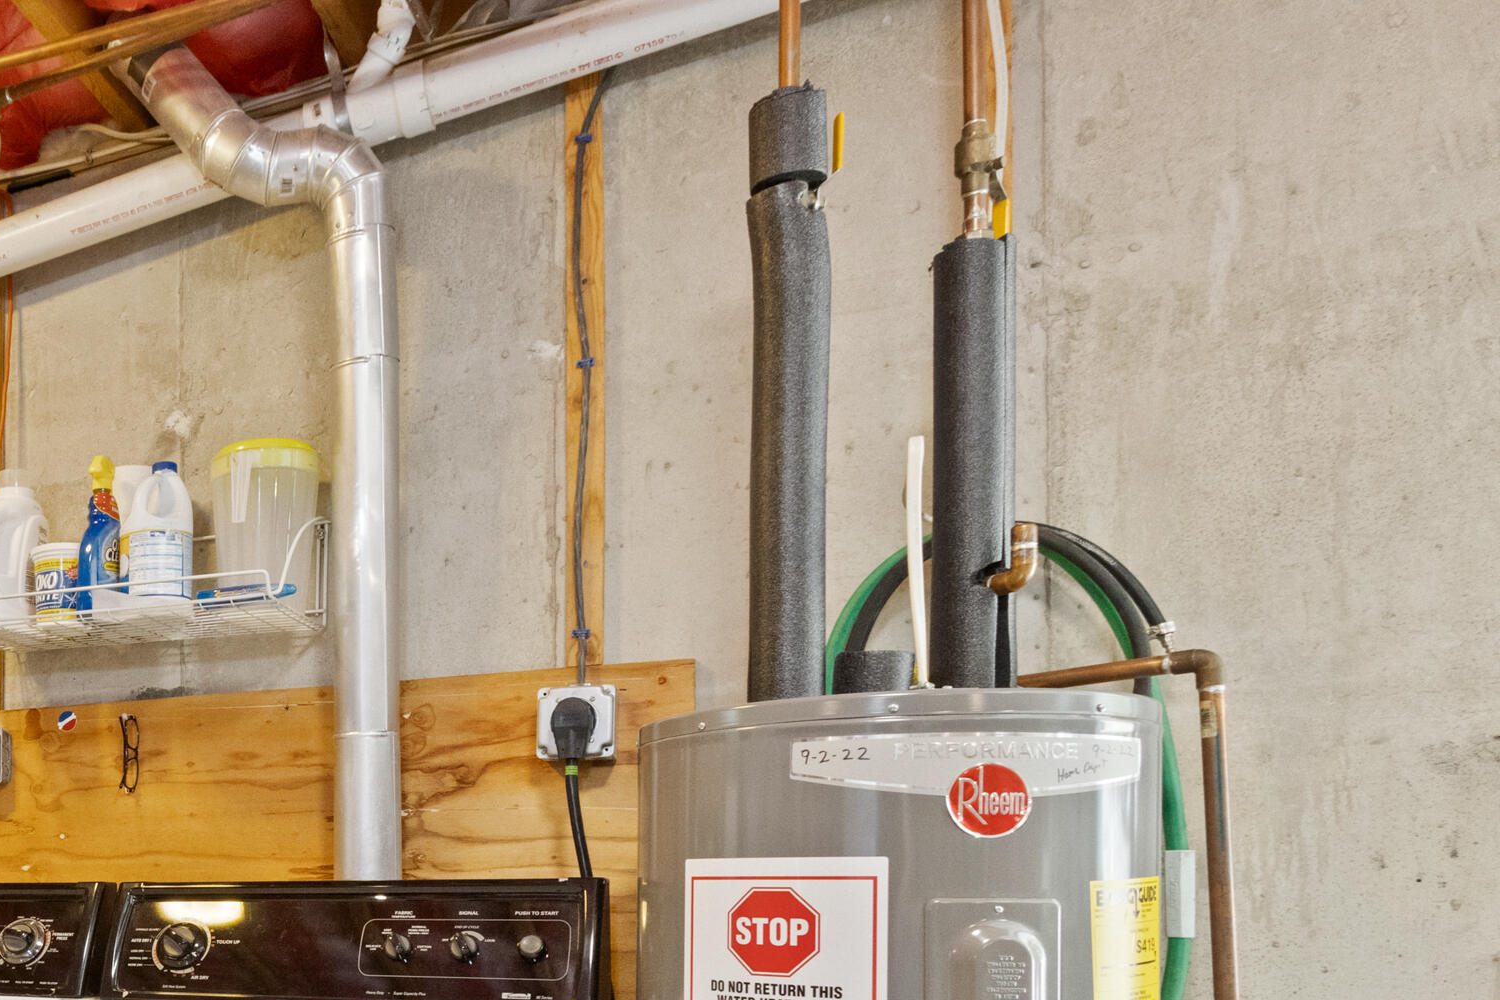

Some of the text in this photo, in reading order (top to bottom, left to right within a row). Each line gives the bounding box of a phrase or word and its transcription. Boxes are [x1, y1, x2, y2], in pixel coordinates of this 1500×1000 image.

[36, 571, 59, 591] OXO
[801, 747, 871, 765] 9-2-22
[894, 742, 1079, 760] PERFORMANCE
[958, 765, 1026, 825] Rheem
[735, 916, 809, 947] STOP
[710, 980, 843, 999] DO NOT RETURN THIS
